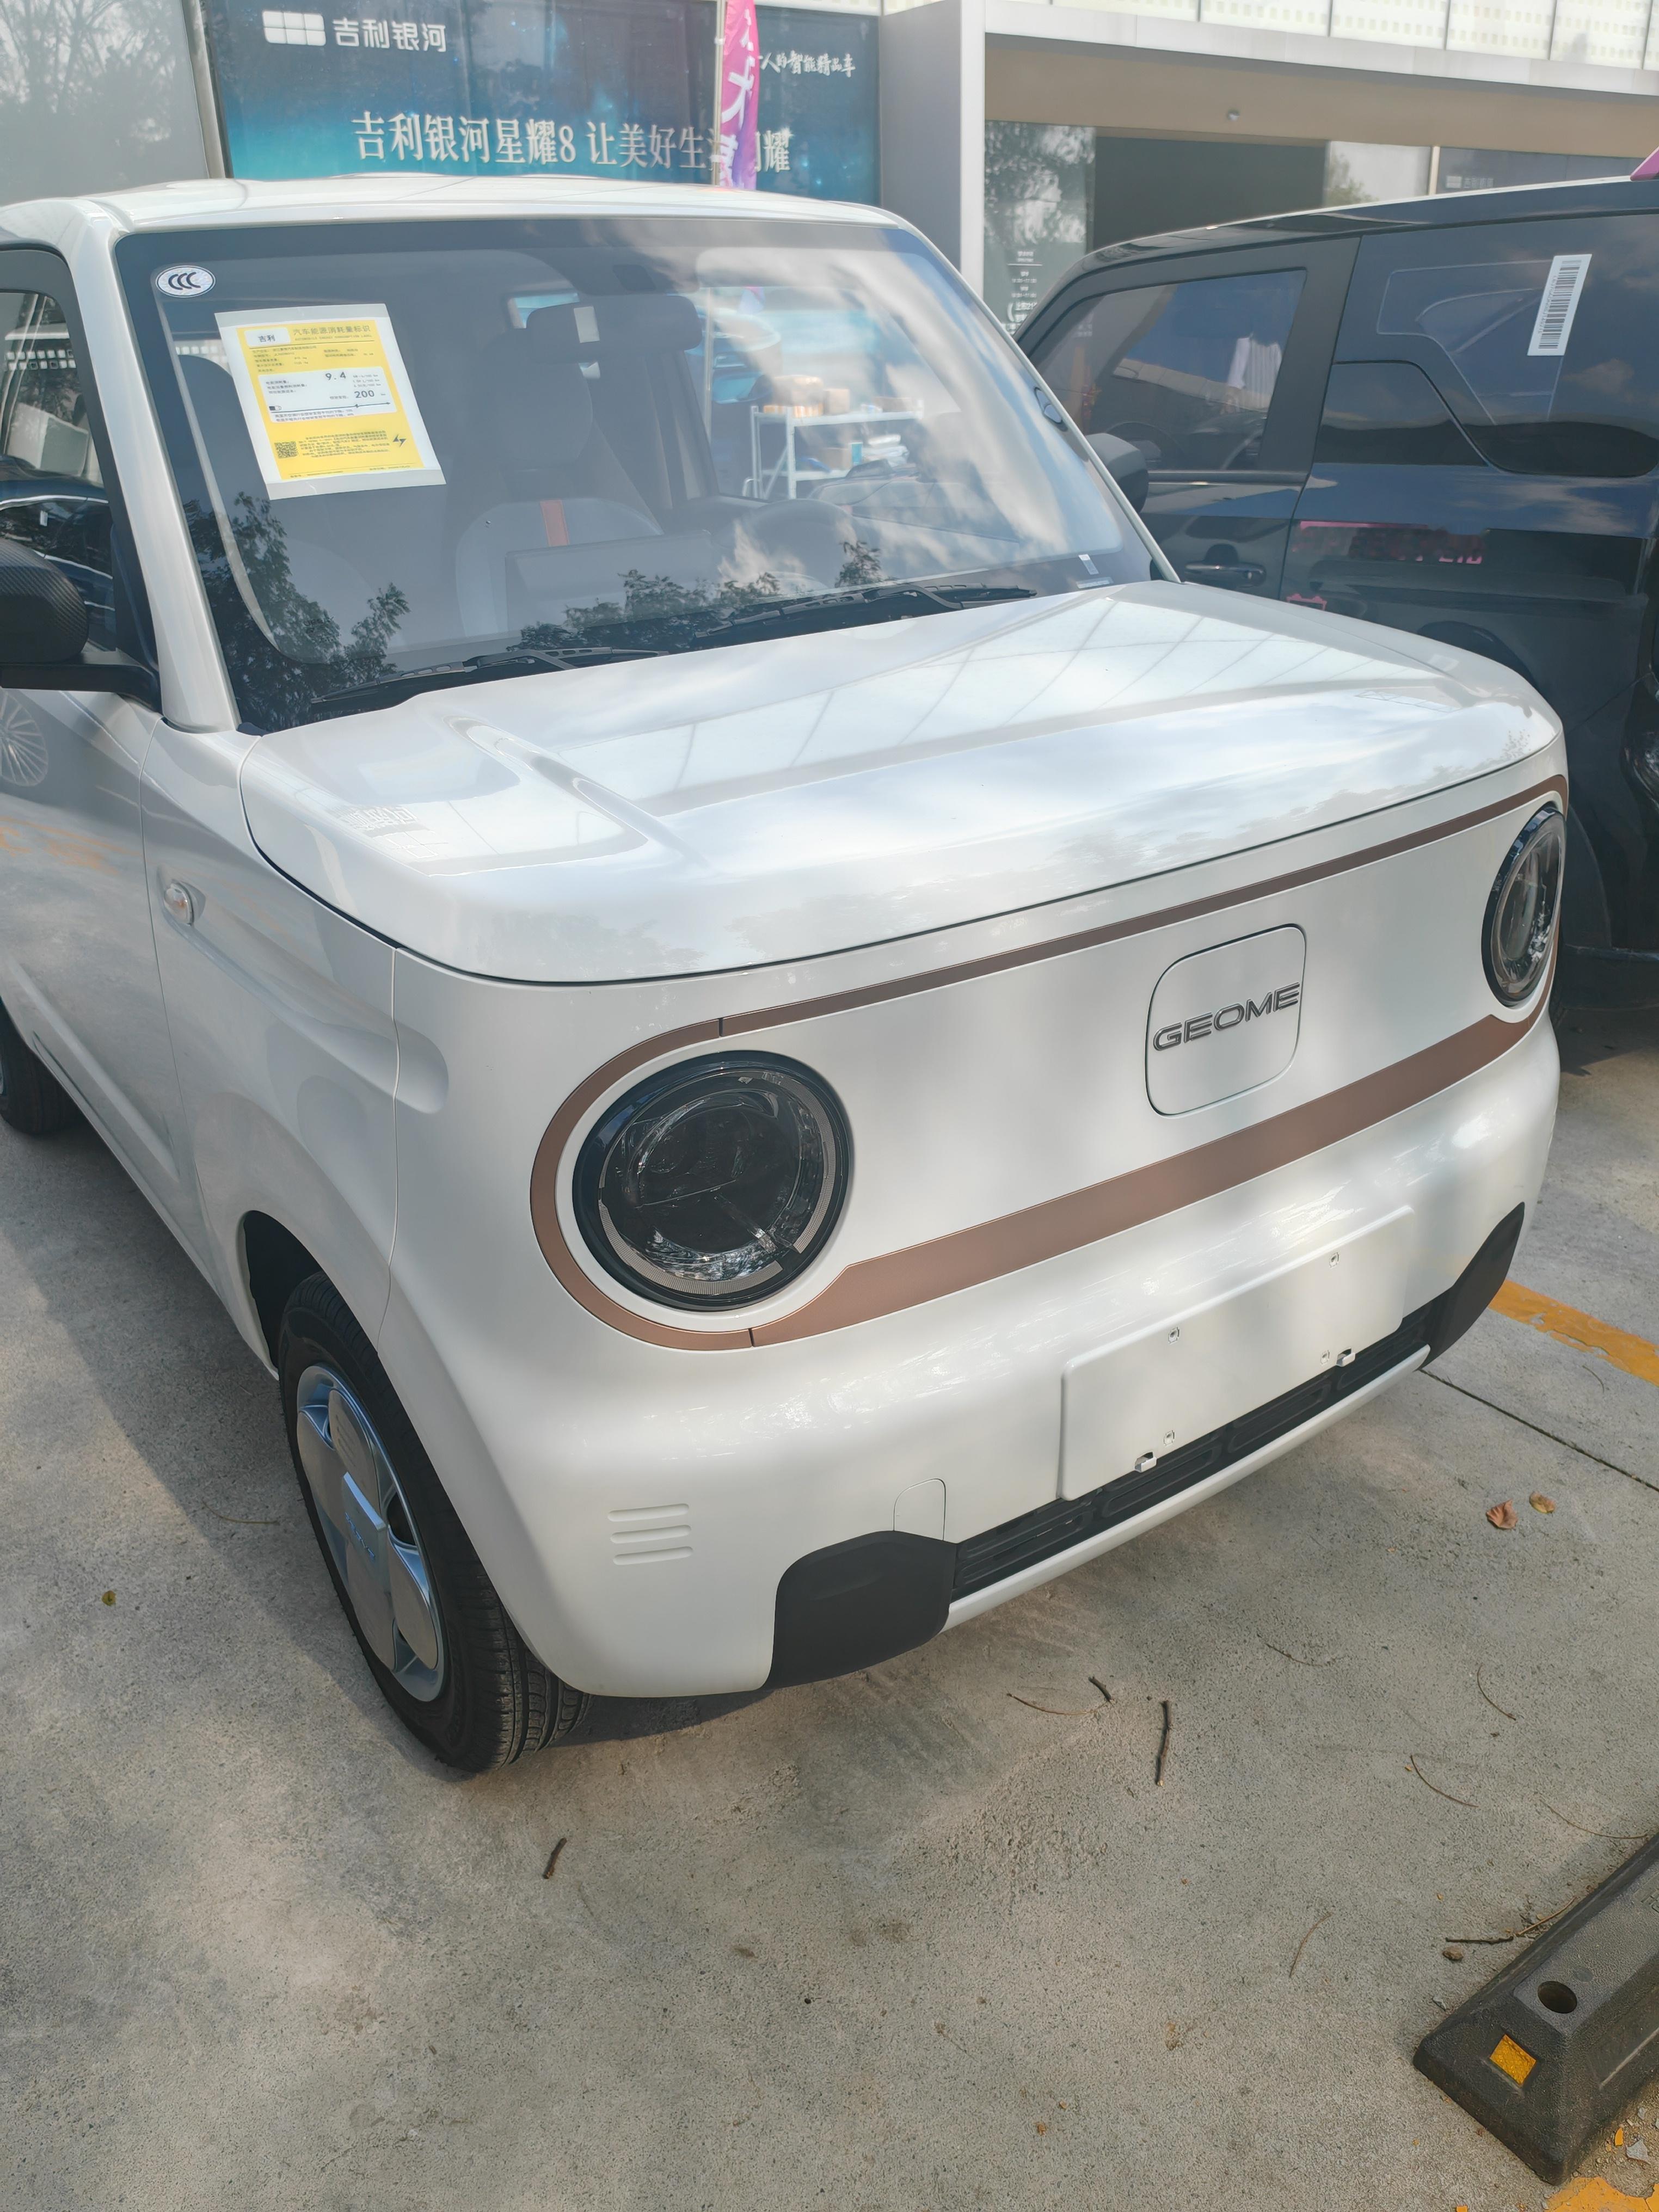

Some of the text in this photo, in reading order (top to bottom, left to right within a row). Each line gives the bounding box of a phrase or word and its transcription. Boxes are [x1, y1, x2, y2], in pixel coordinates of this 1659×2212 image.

[333, 17, 447, 53] 吉利银河
[758, 50, 856, 77] 人的智能精品车
[351, 110, 792, 173] 吉利银河星耀8 让美好生耀
[258, 334, 276, 342] 吉利
[293, 325, 371, 335] 汽车能源消耗量标识
[354, 390, 375, 399] 200
[1153, 982, 1300, 1051] GEOME
